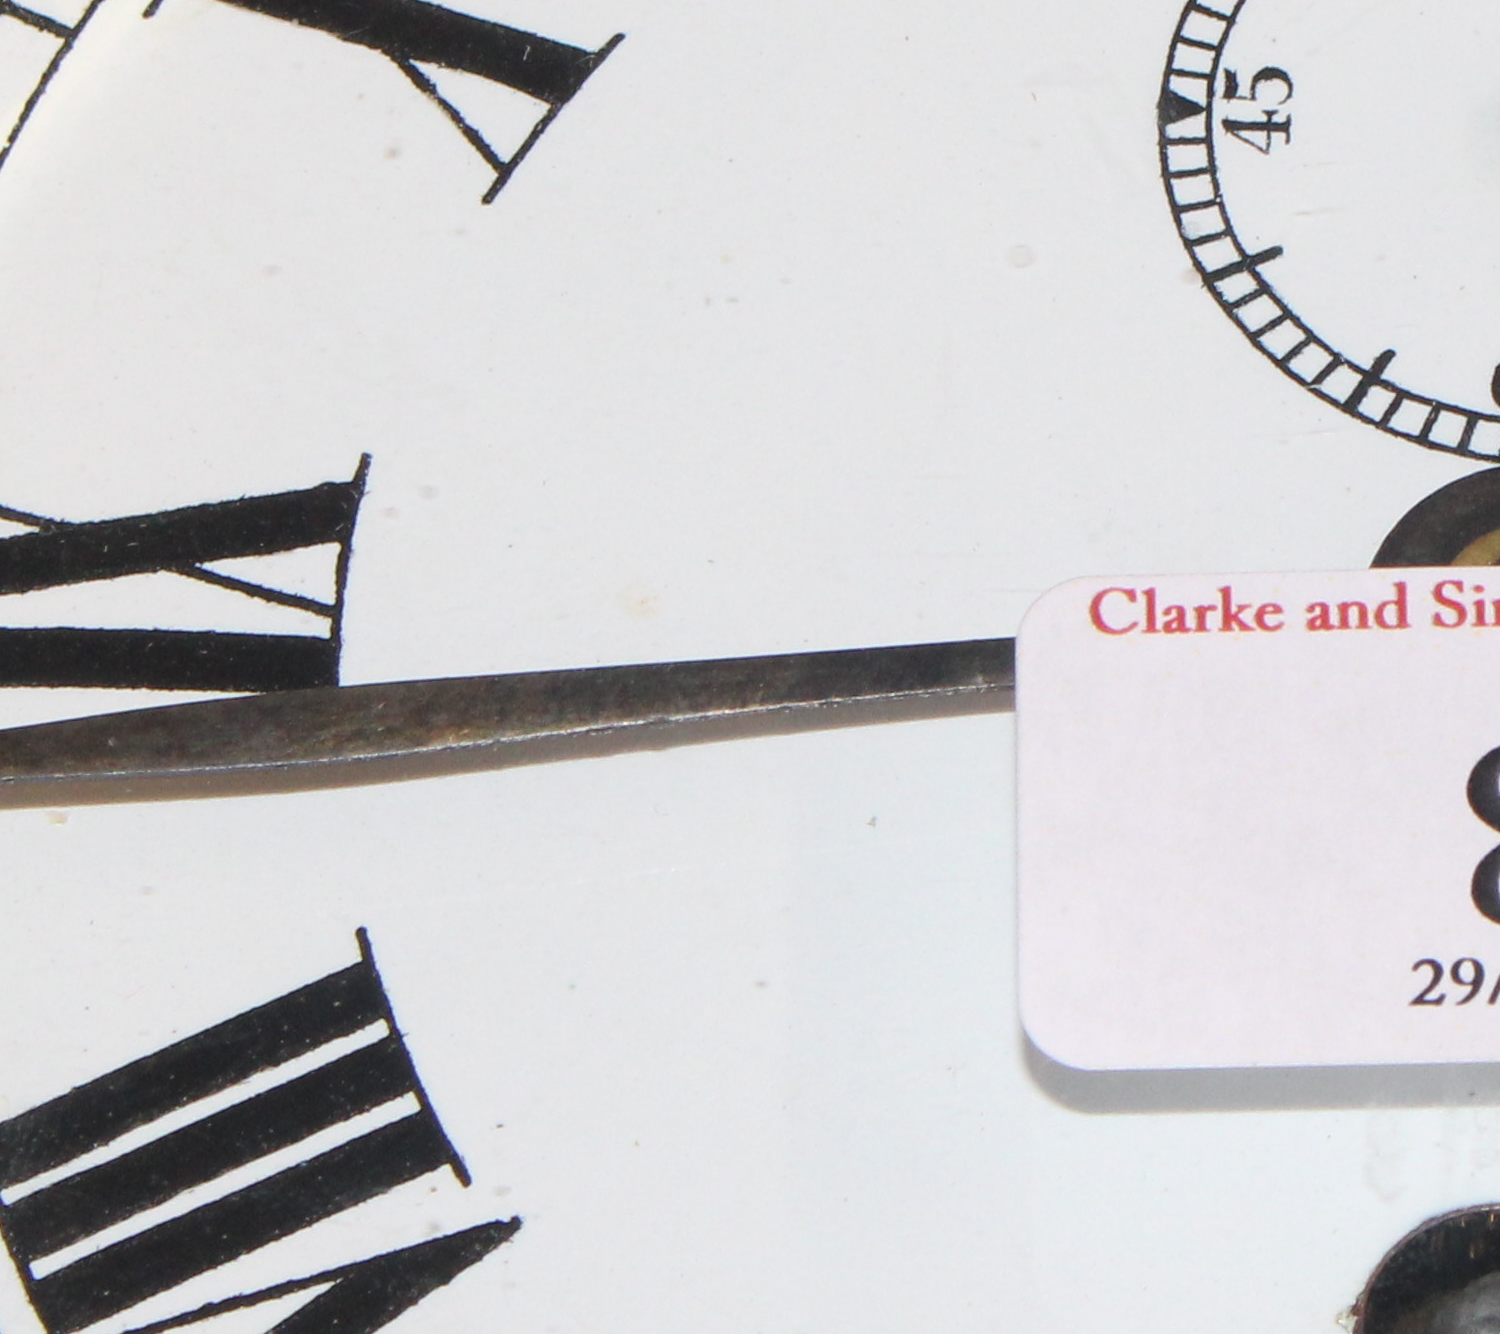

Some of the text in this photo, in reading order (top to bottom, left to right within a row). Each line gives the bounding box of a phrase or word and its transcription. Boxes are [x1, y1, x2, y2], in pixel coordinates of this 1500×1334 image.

[1221, 64, 1294, 156] 45
[1089, 587, 1286, 635] Clarke
[1305, 580, 1411, 632] and
